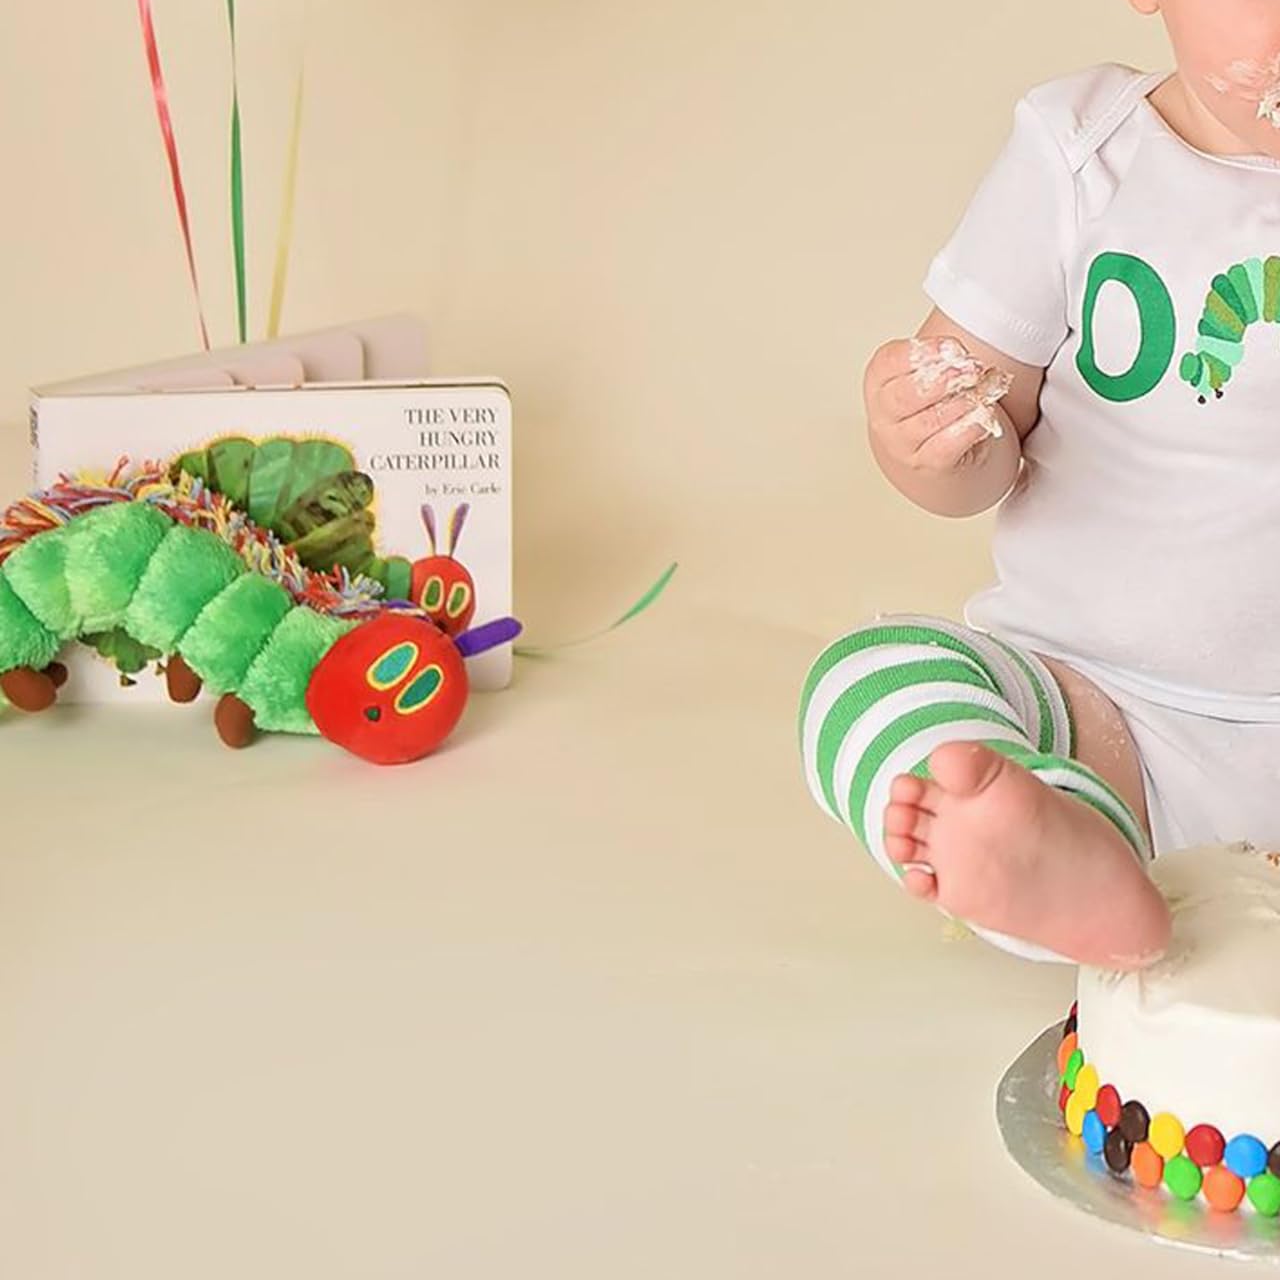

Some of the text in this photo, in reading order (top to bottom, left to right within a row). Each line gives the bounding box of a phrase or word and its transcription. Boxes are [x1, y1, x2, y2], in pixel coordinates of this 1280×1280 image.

[405, 408, 498, 424] THE VERY
[420, 431, 498, 447] HUNGRY
[370, 453, 501, 470] CATERPILLAR
